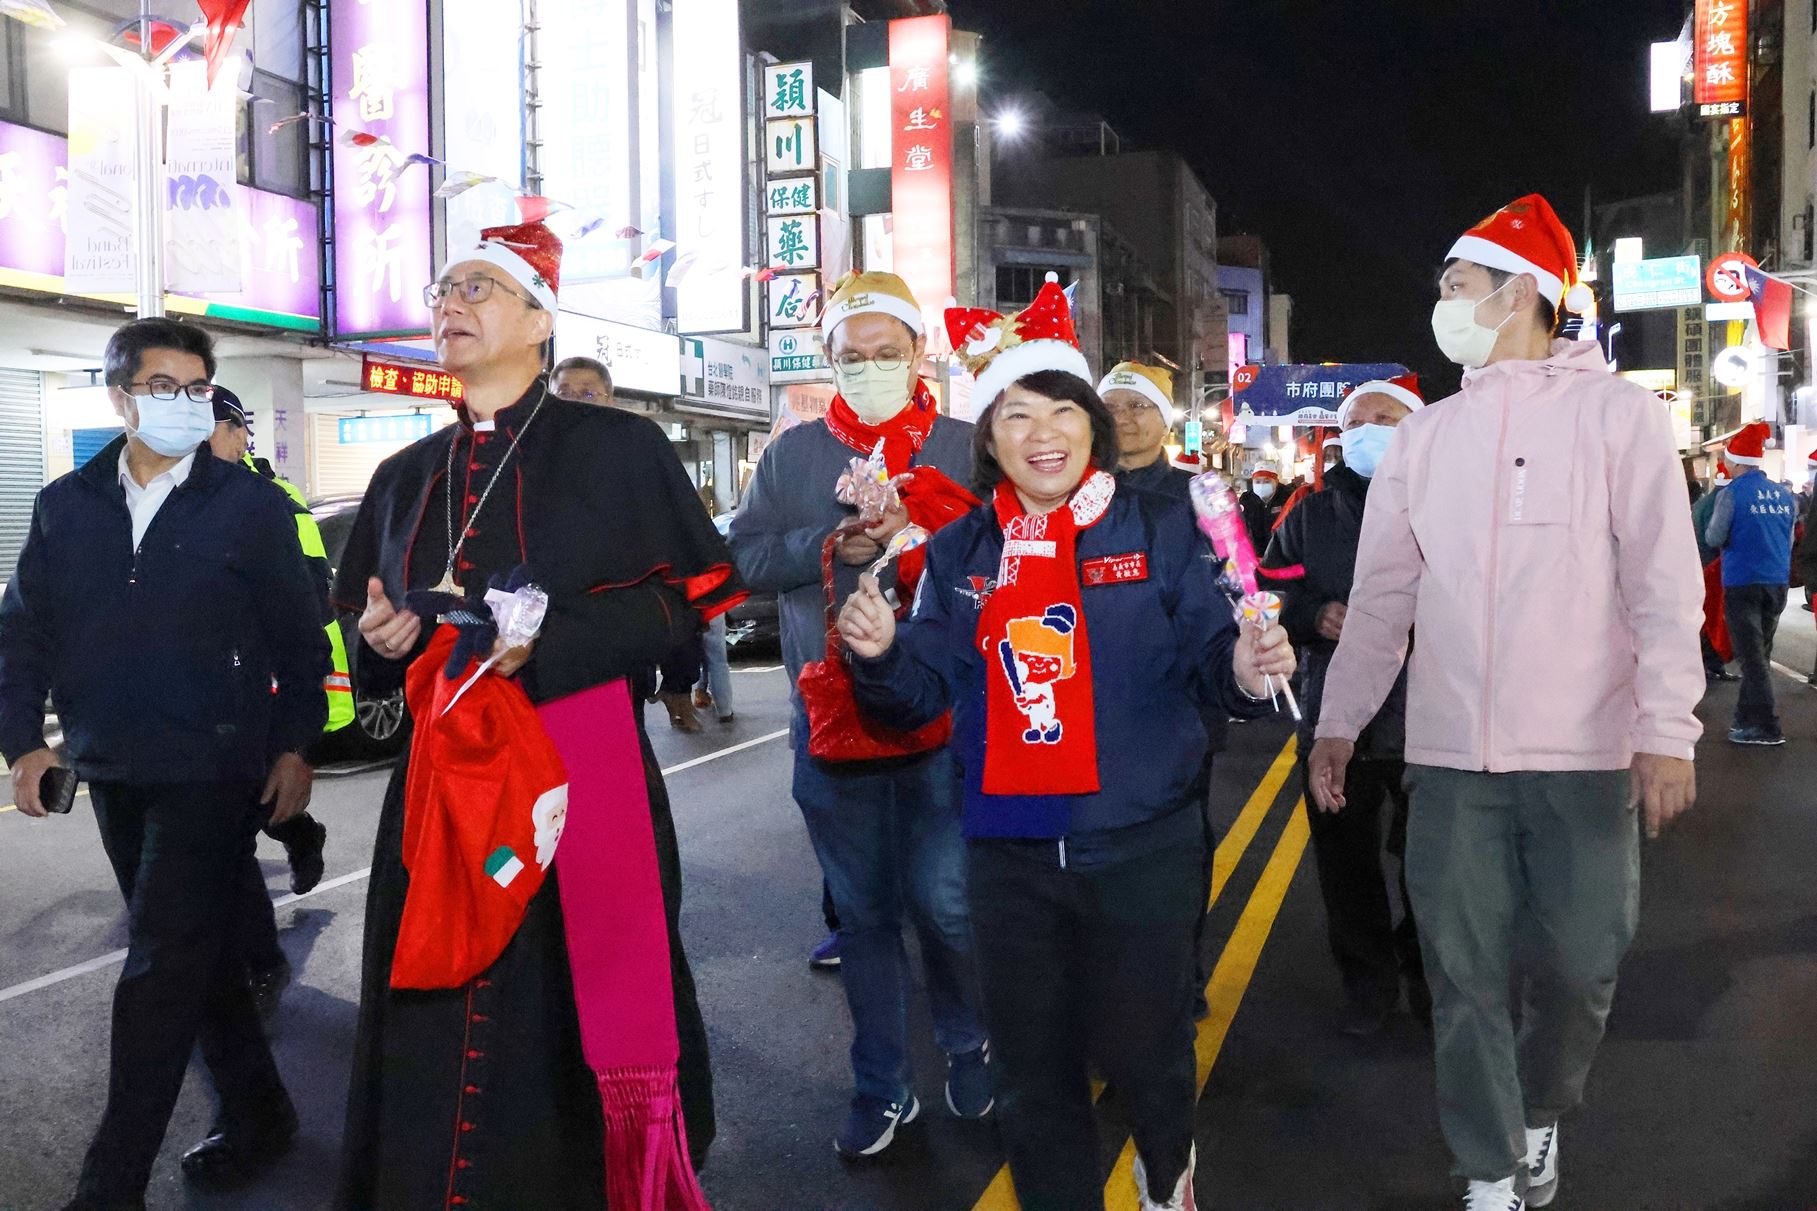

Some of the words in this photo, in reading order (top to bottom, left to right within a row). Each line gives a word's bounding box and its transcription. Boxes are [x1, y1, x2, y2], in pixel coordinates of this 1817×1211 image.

[1706, 1, 1736, 86] 方塊酥
[898, 65, 937, 172] 廣生堂
[1237, 372, 1251, 383] 02
[275, 410, 289, 482] 天祥
